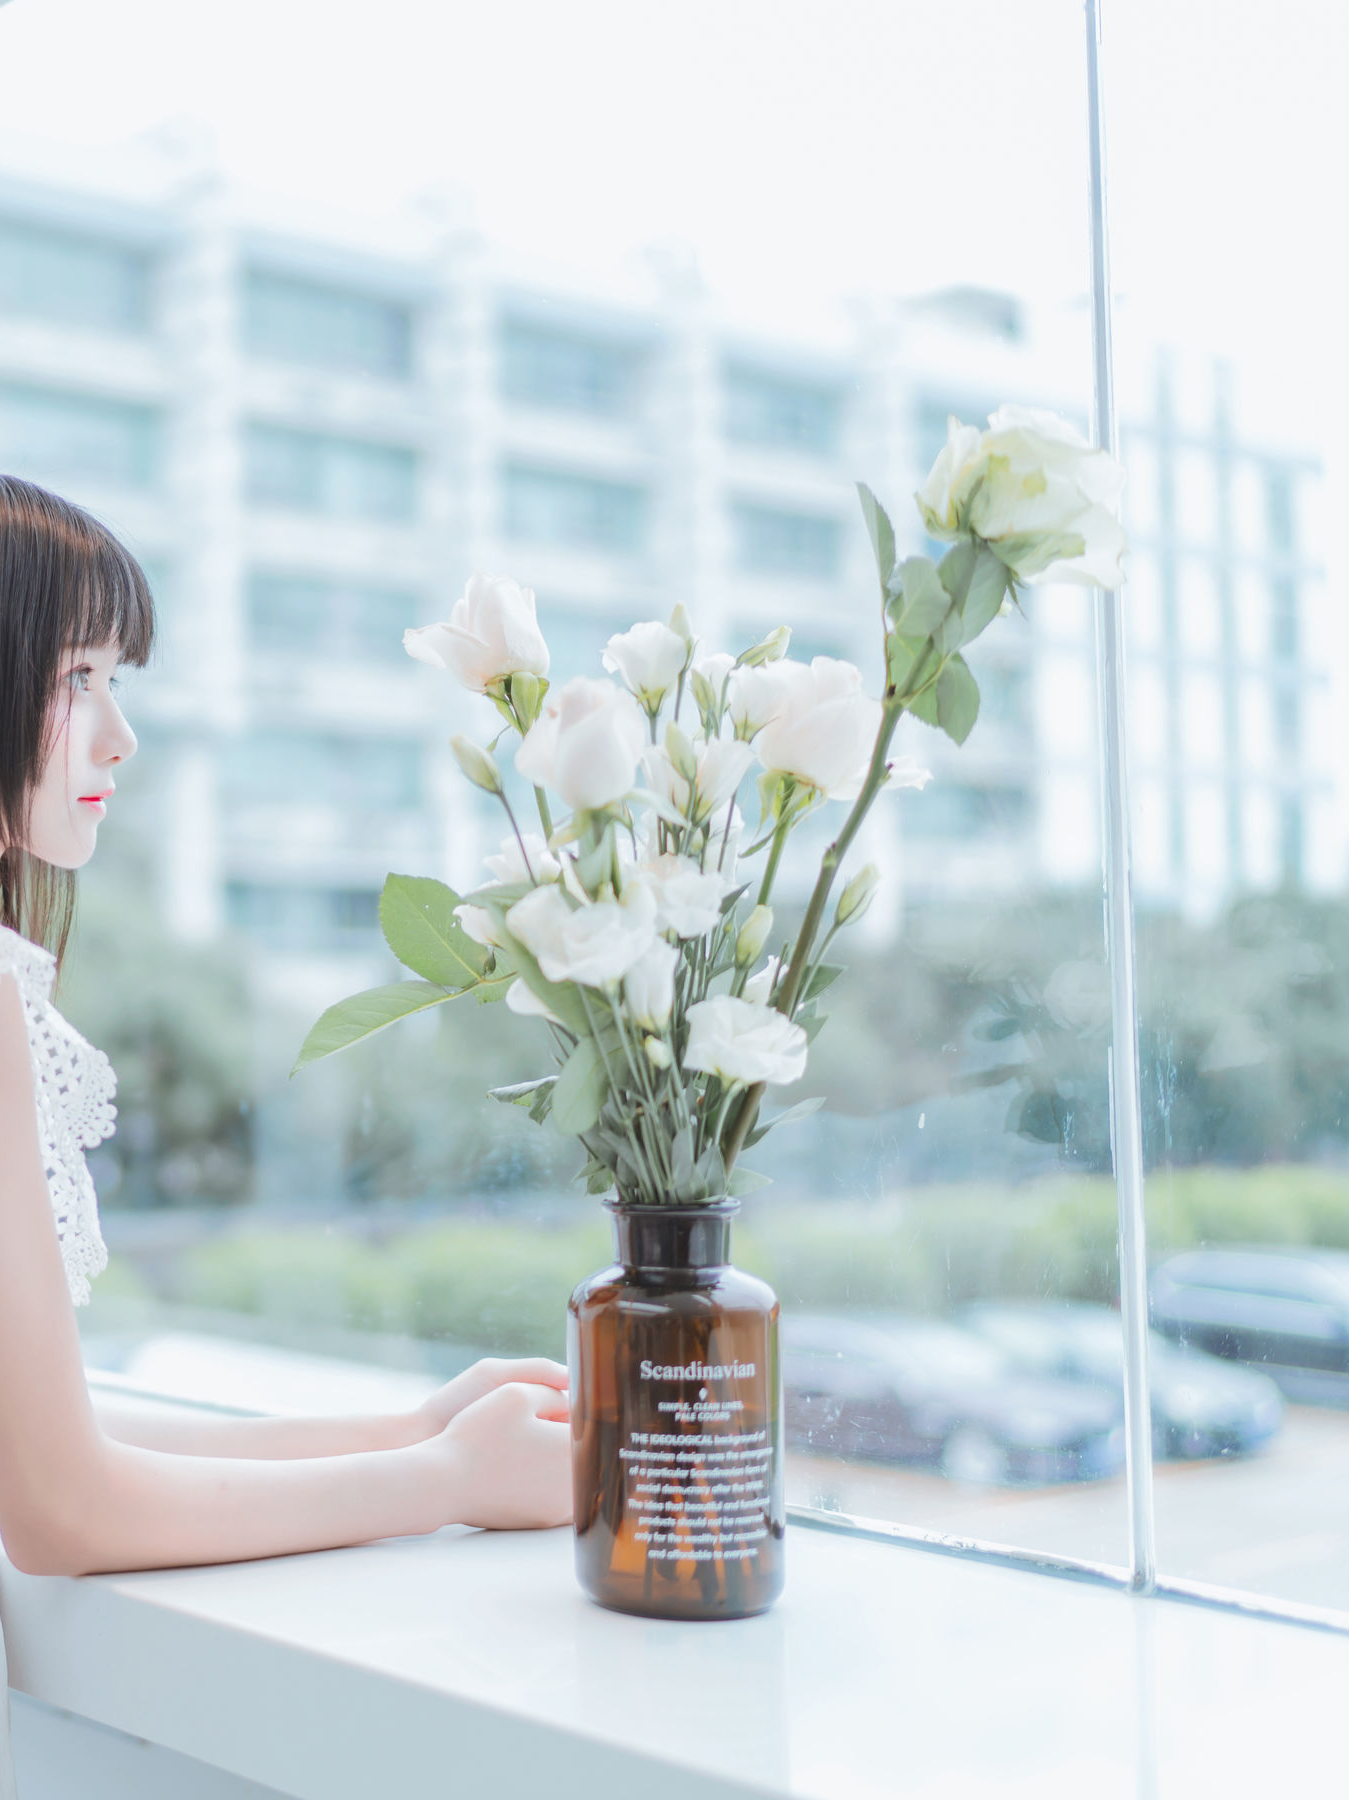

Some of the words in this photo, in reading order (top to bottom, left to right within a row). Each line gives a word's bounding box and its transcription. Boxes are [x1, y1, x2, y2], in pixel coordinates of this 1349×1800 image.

[640, 1360, 755, 1380] Scandinavian
[693, 1402, 720, 1412] CLEAN
[675, 1412, 696, 1421] PALE
[698, 1412, 731, 1421] COLORS
[631, 1433, 648, 1444] THE
[650, 1433, 713, 1446] IDEOLOGICAL
[714, 1431, 758, 1446] background
[619, 1448, 675, 1460] Scandinavian
[676, 1452, 706, 1464] design
[707, 1453, 725, 1461] was
[726, 1451, 739, 1460] the
[647, 1467, 689, 1479] particular
[690, 1467, 744, 1478] Scandinavian
[636, 1483, 661, 1494] social
[662, 1484, 710, 1496] democracy
[712, 1484, 731, 1494] after
[628, 1498, 643, 1509] The
[644, 1500, 664, 1511] idea
[665, 1501, 683, 1512] that
[685, 1501, 722, 1512] beautiful
[724, 1500, 739, 1511] and
[639, 1516, 676, 1527] products
[677, 1517, 706, 1527] should
[708, 1518, 722, 1527] not
[723, 1517, 733, 1526] be
[635, 1532, 652, 1544] only
[654, 1532, 666, 1543] for
[668, 1533, 682, 1543] the
[684, 1533, 718, 1545] wealthy
[719, 1533, 733, 1543] but
[648, 1549, 666, 1560] and
[667, 1549, 711, 1560] affordable
[714, 1551, 722, 1560] to
